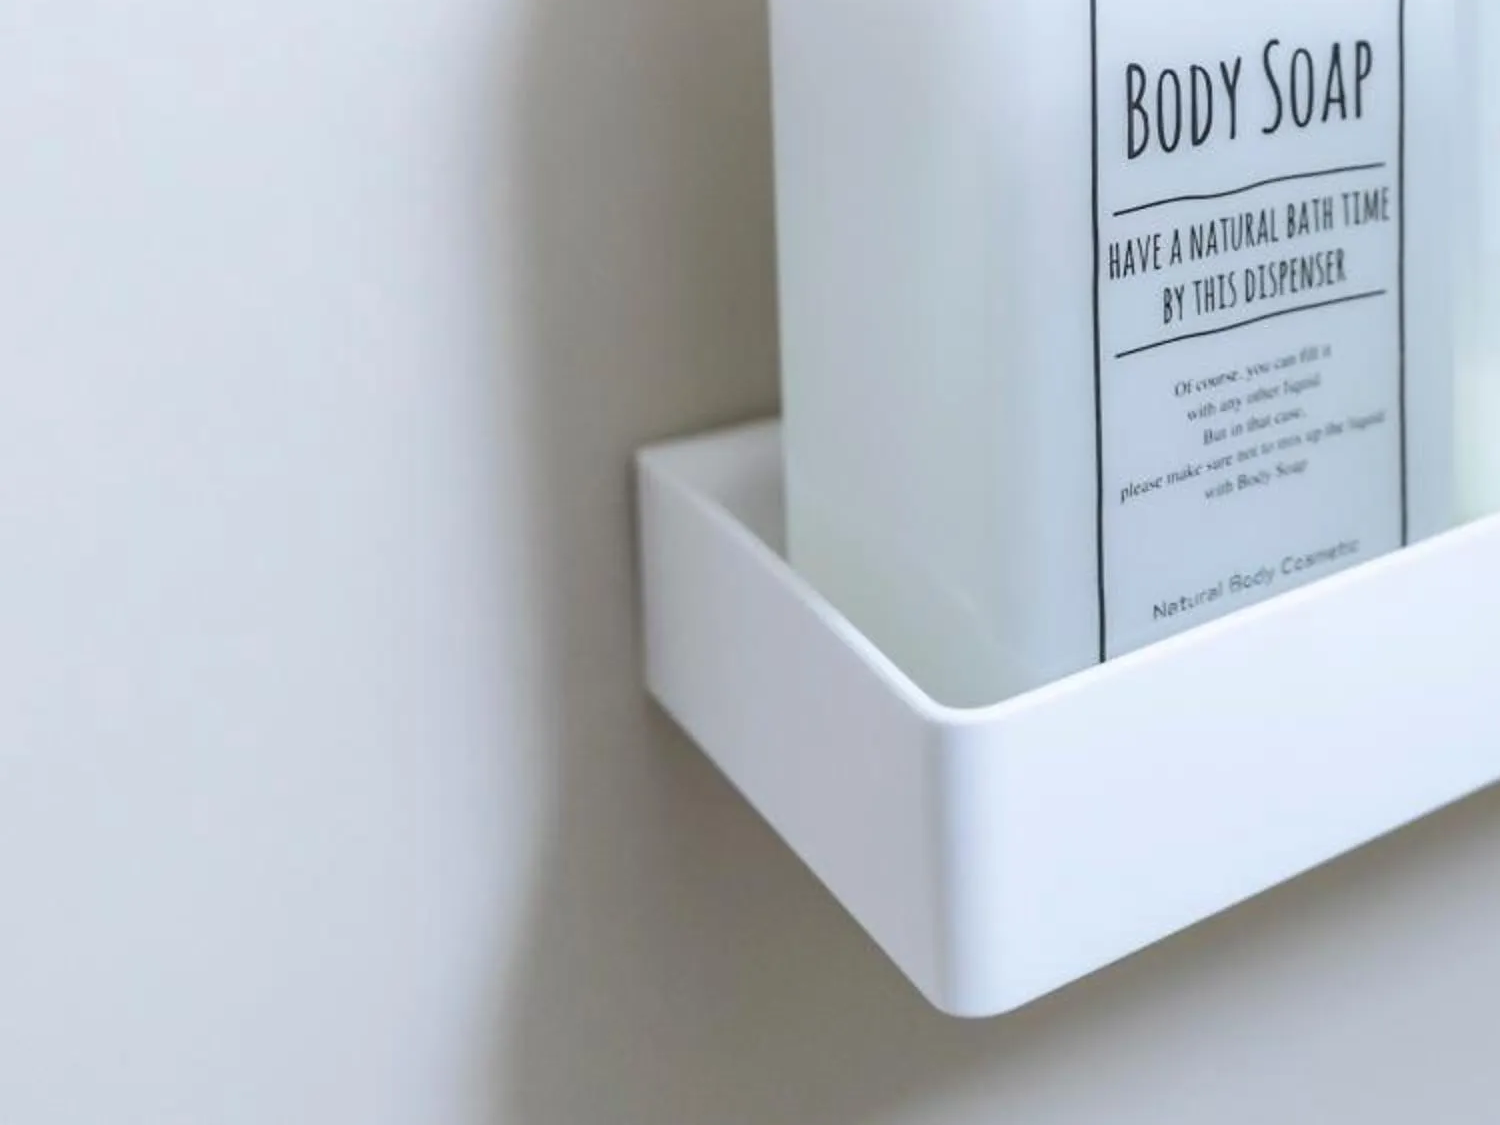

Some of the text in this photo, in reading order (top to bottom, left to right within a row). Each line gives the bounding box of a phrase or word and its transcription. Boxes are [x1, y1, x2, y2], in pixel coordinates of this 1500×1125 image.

[1126, 38, 1372, 159] BODY SOAP
[1108, 186, 1390, 280] HAVE A NATURAL BATH TIME
[1163, 247, 1346, 325] BY THIS DISPENSER
[1174, 378, 1193, 397] Of
[1246, 362, 1271, 381] you
[1273, 354, 1297, 371] can
[1321, 343, 1331, 358] it
[1187, 402, 1217, 421] with
[1219, 397, 1242, 414] any
[1246, 386, 1281, 405] other
[1120, 473, 1162, 503] please
[1166, 461, 1201, 484] make
[1206, 455, 1233, 472] sure
[1237, 446, 1258, 462] not
[1261, 440, 1275, 455] to
[1305, 427, 1323, 444] up
[1203, 427, 1227, 446] But
[1230, 424, 1244, 438] in
[1246, 413, 1271, 433] that
[1204, 480, 1235, 501] with
[1237, 471, 1272, 492] Body
[1153, 539, 1361, 619] Natural Body Cosmetic
